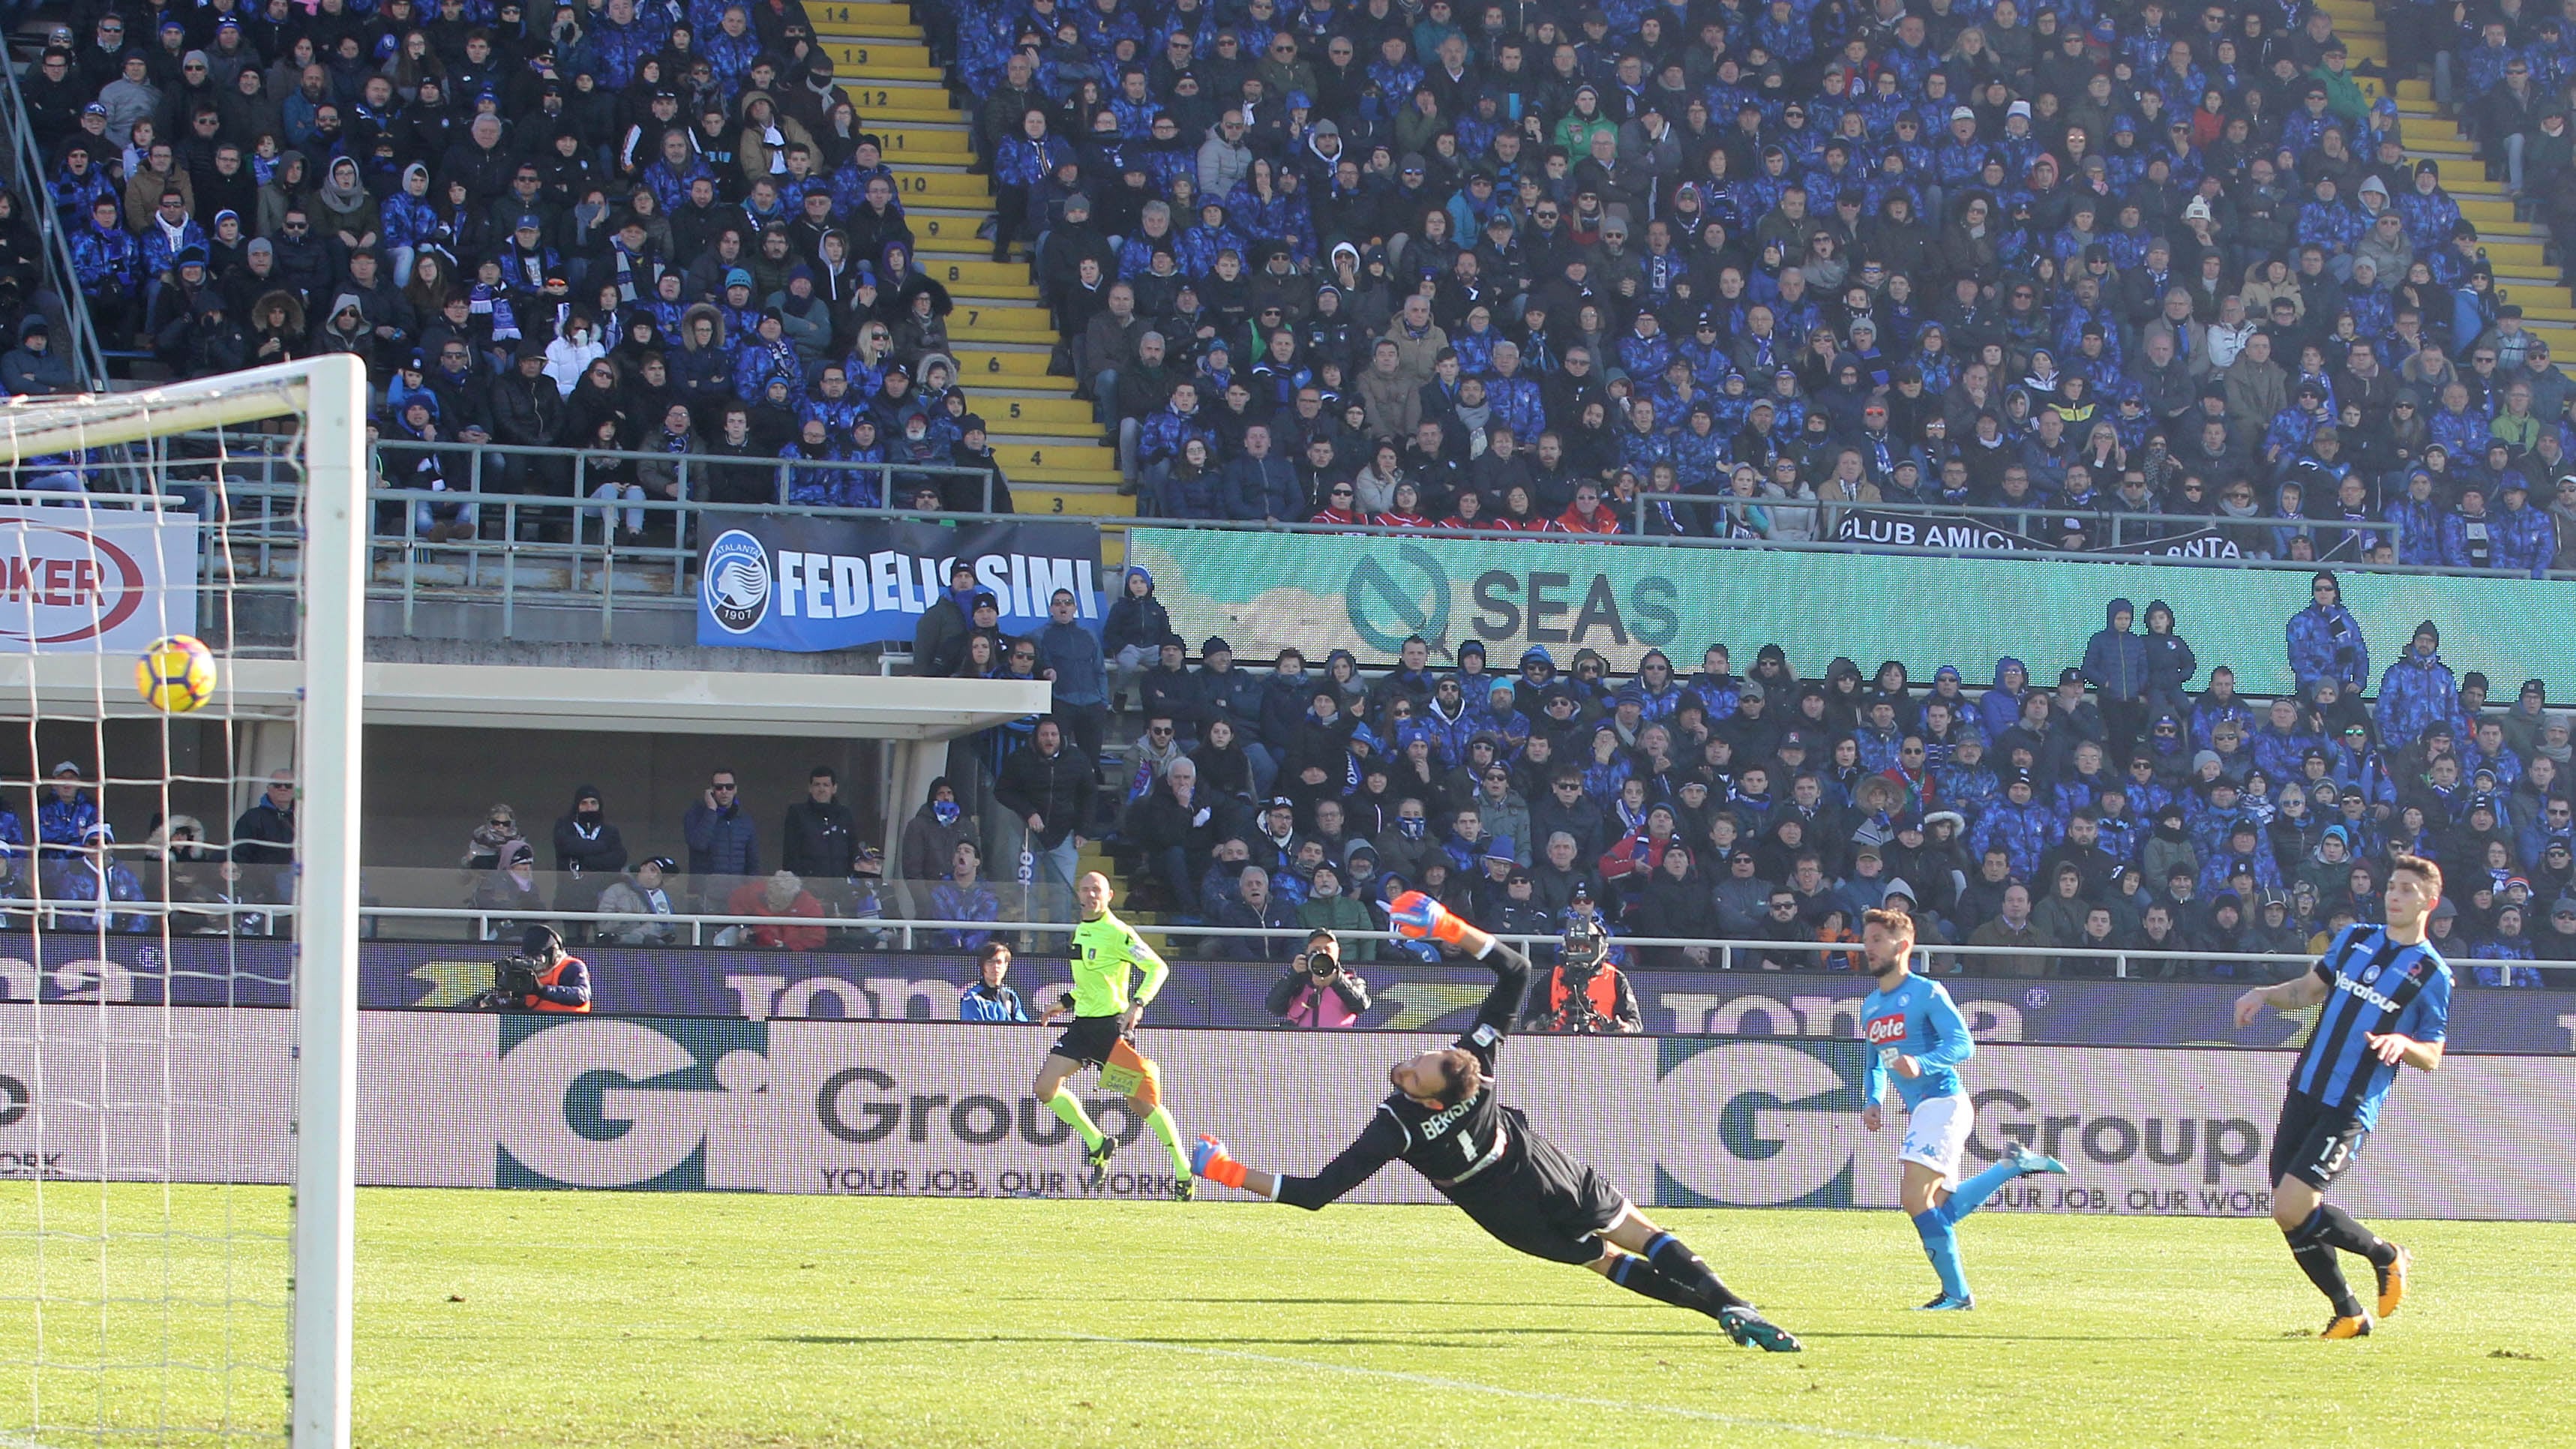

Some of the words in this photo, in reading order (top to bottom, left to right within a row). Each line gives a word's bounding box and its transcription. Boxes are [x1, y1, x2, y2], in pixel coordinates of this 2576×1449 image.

[826, 7, 849, 22] 14
[844, 49, 868, 64] 13
[863, 91, 888, 106] 12
[882, 134, 904, 149] 11
[902, 177, 927, 193] 10
[928, 221, 939, 236] 9
[949, 266, 959, 281] 8
[968, 311, 978, 326] 7
[988, 357, 1000, 372] 6
[1010, 403, 1021, 418] 5
[1030, 451, 1042, 466] 4
[1052, 497, 1063, 513] 3
[715, 544, 760, 556] ATALANTA
[724, 609, 752, 621] 1907
[1471, 569, 1679, 646] SEAS
[2320, 1136, 2347, 1171] 13
[821, 1168, 907, 1190] YOUR
[919, 1169, 986, 1196] JOB,
[1000, 1172, 1065, 1193] OUR
[2052, 1188, 2114, 1212] JOB,
[2127, 1190, 2188, 1210] OUR
[2200, 1192, 2272, 1212] WOR
